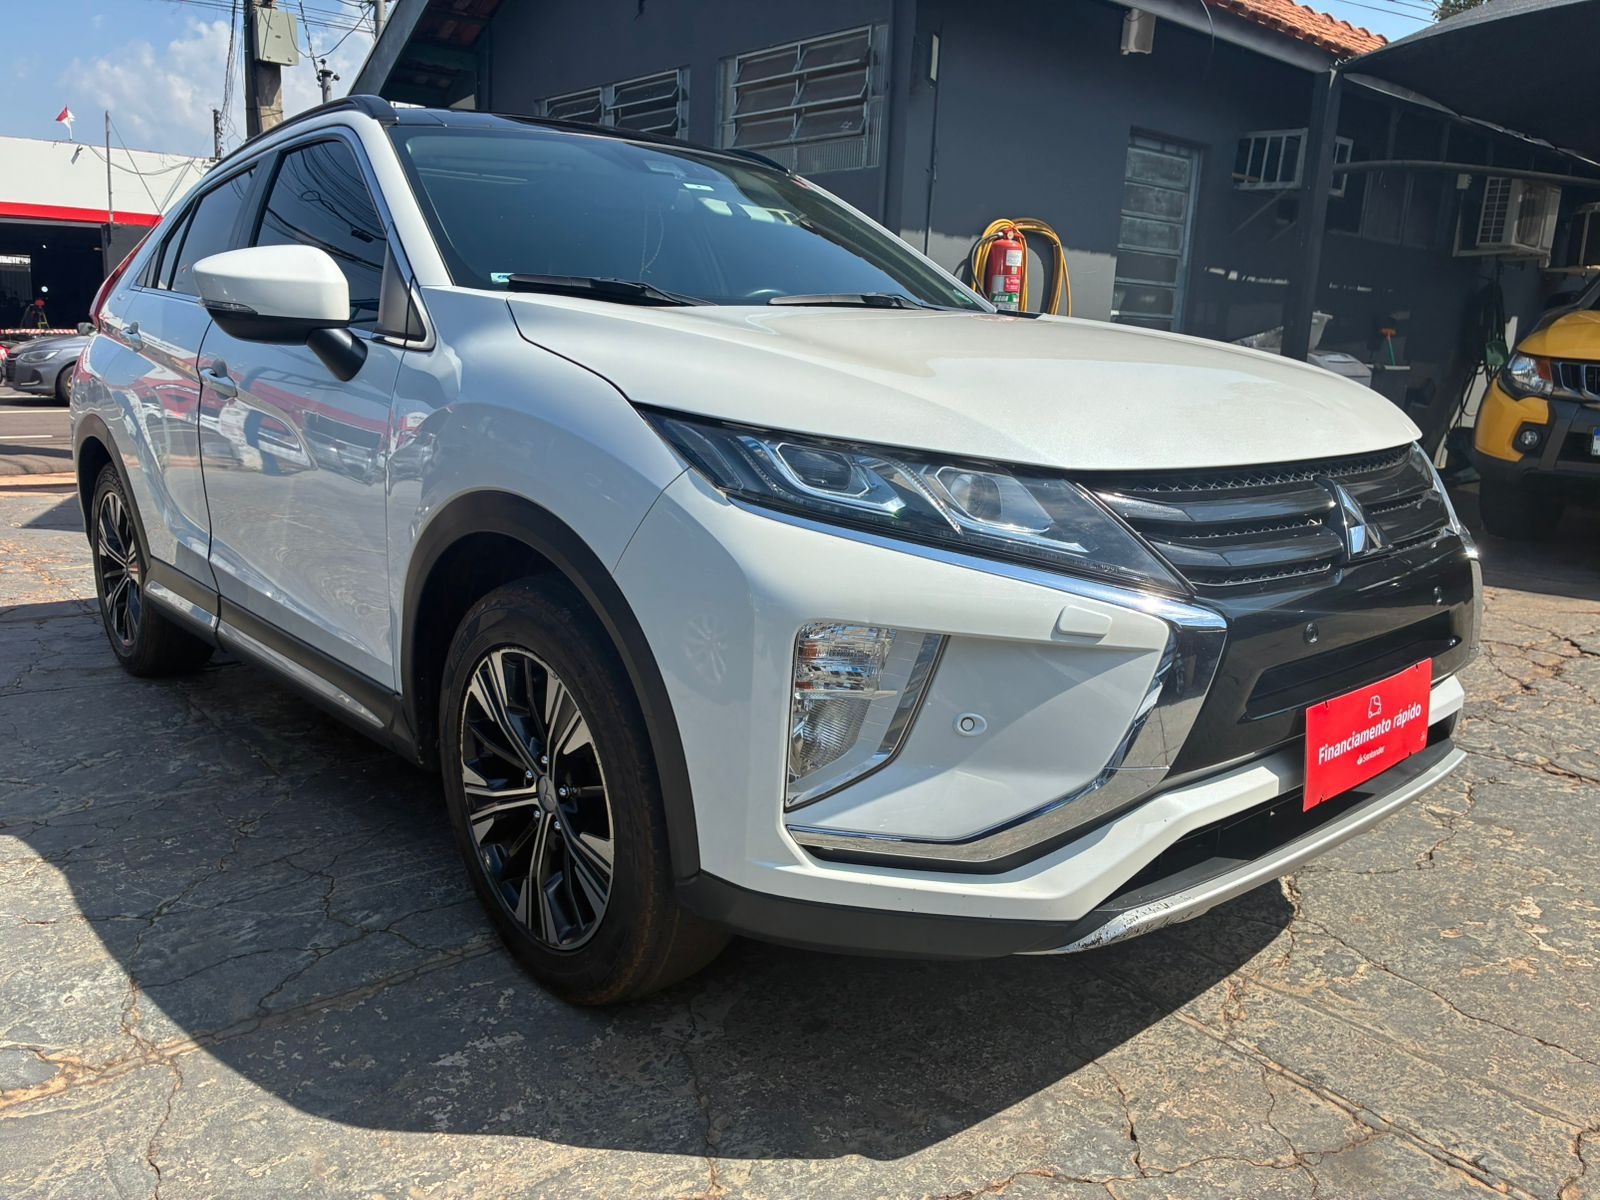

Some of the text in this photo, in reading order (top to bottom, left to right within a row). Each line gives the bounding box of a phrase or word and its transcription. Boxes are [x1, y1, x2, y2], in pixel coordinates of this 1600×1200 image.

[1318, 701, 1422, 765] Financiamento rápido
[1363, 746, 1385, 763] Santander
